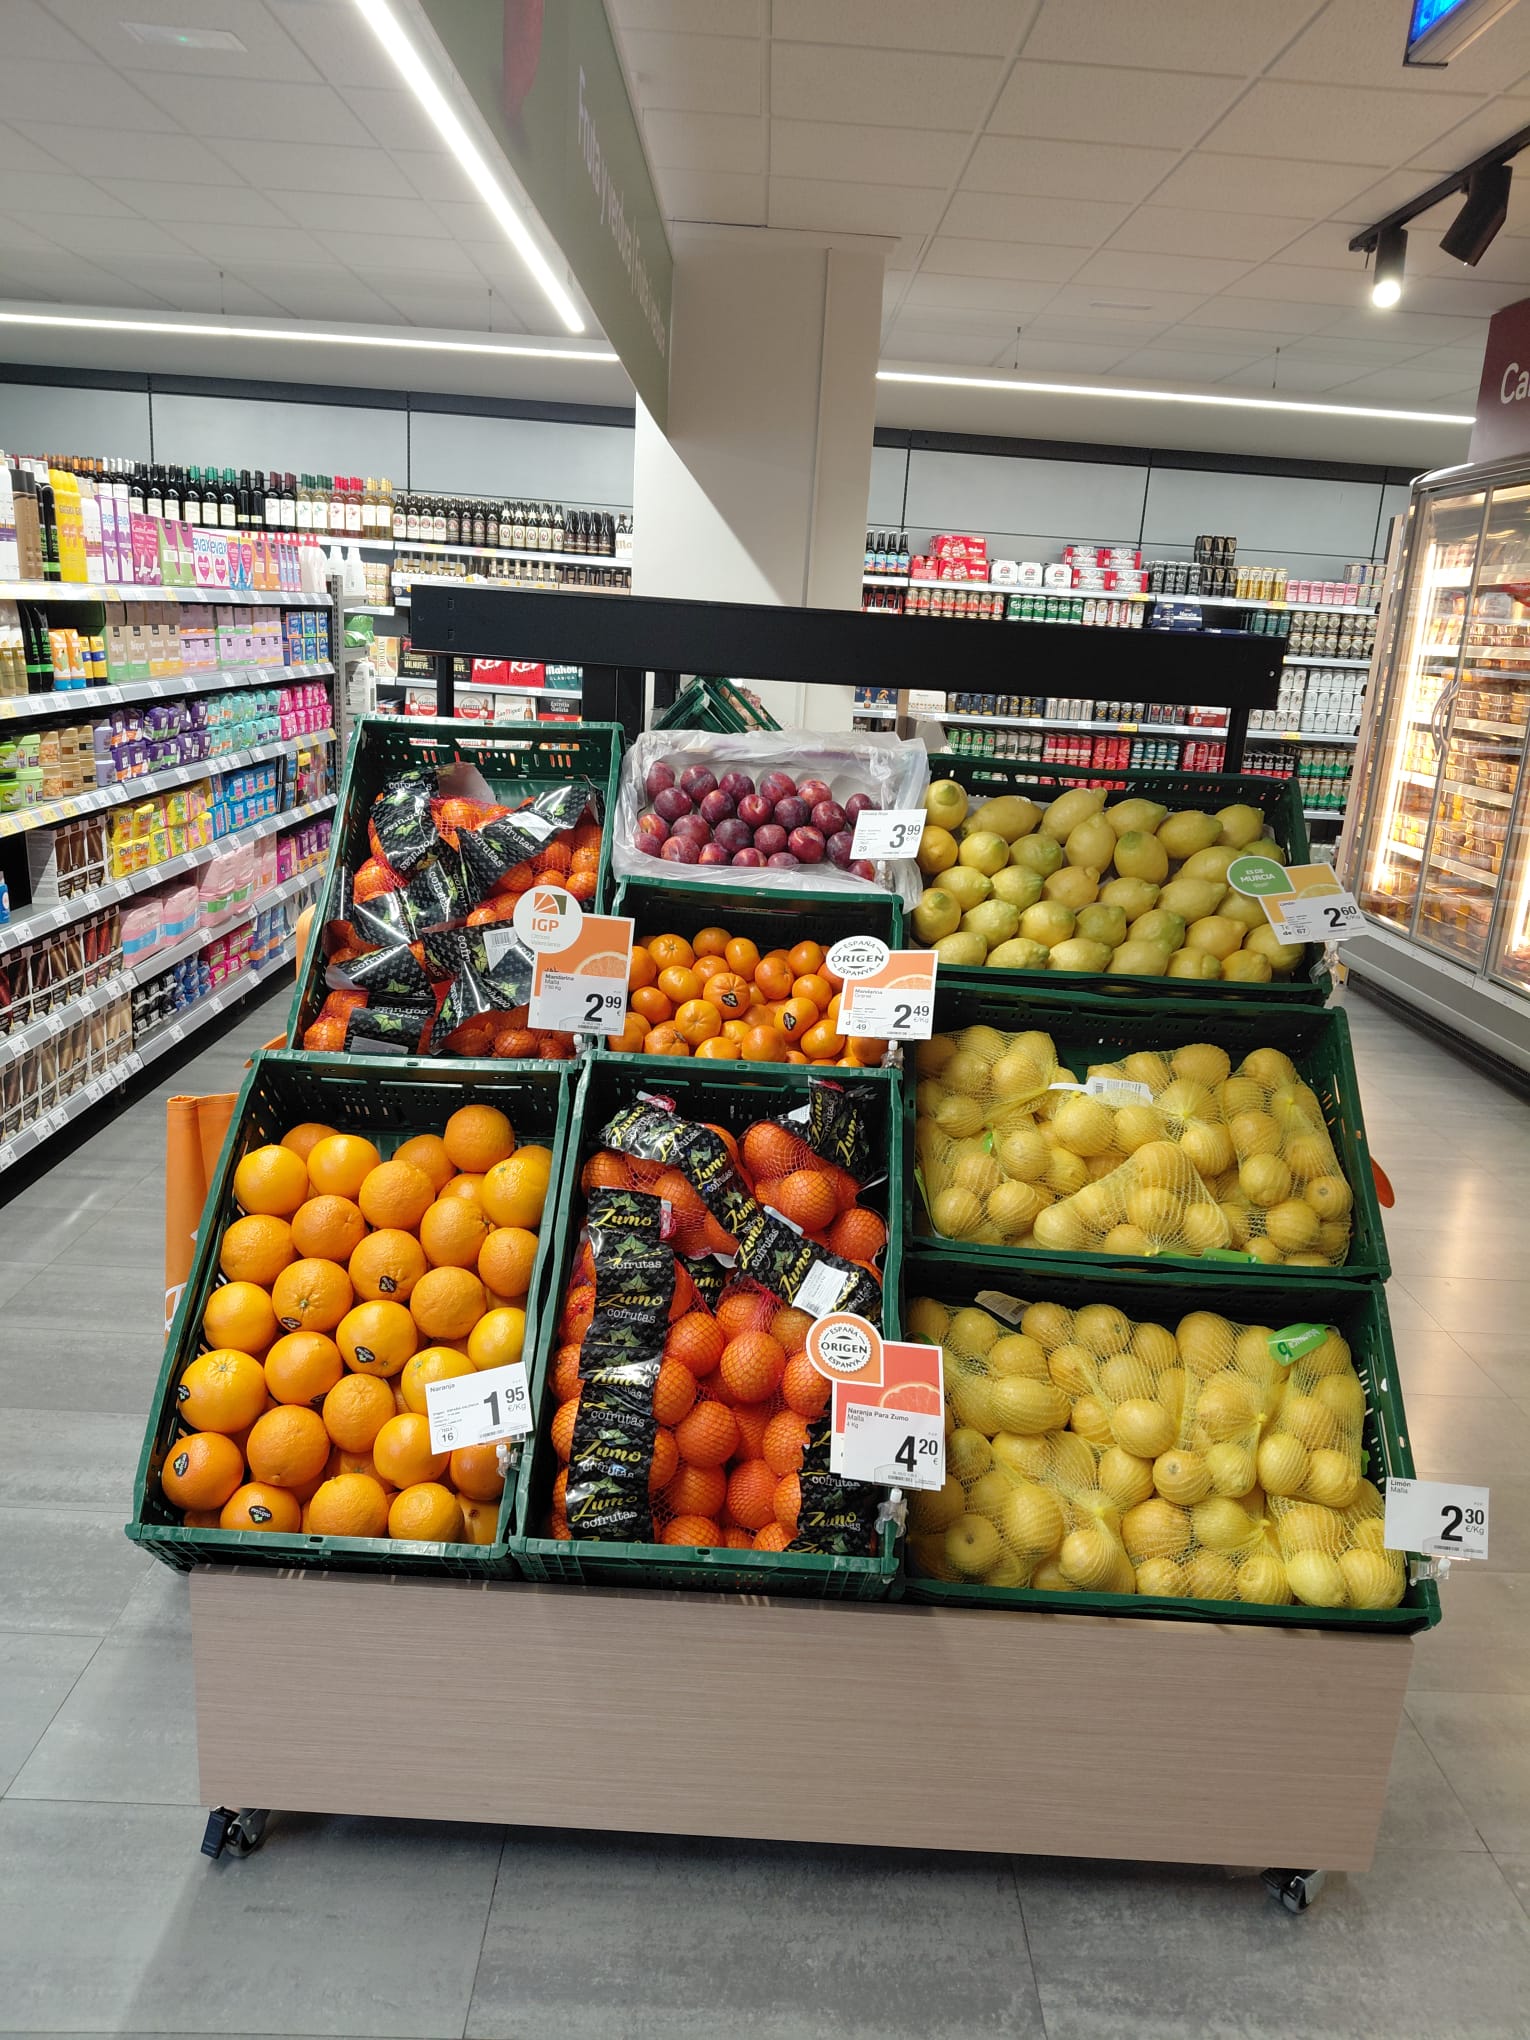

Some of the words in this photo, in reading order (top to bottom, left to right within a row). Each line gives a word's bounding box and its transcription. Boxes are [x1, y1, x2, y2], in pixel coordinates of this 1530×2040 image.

[578, 64, 600, 195] Fruta
[601, 158, 608, 225] y
[1500, 361, 1530, 405] Ca
[193, 537, 210, 551] evax
[210, 540, 227, 555] evax
[546, 665, 577, 675] Mahou
[889, 824, 906, 848] 3
[907, 824, 921, 835] 99
[1240, 873, 1276, 883] MURCIA
[1323, 907, 1346, 928] 2
[1341, 905, 1357, 916] 60
[531, 917, 560, 933] IGP
[831, 954, 885, 963] ORIGEN
[837, 966, 876, 977] ESPANYA
[583, 993, 604, 1023] 2
[605, 995, 622, 1009] 99
[892, 1004, 912, 1029] 2
[913, 1005, 930, 1017] 49
[856, 1023, 867, 1031] 49
[693, 1151, 727, 1190] Zumo
[591, 1207, 653, 1229] Zumo
[751, 1228, 779, 1268] cofrutas
[693, 1276, 723, 1289] umo
[779, 1247, 812, 1304] Zumo
[598, 1293, 664, 1309] Zumo
[606, 1308, 657, 1324] cofrutas
[829, 1326, 859, 1337] ESPAÑA
[820, 1341, 868, 1355] ORIGEN
[827, 1356, 862, 1369] ESPANYA
[430, 1383, 456, 1393] Naranja
[483, 1390, 501, 1426] 1
[505, 1386, 525, 1404] 95
[507, 1403, 526, 1412] €/Kg
[590, 1409, 646, 1428] cofrutas
[847, 1414, 865, 1422] Malla
[848, 1407, 873, 1417] Naranja
[874, 1411, 889, 1419] Para
[890, 1413, 910, 1422] Zumo
[441, 1432, 454, 1443] 16
[573, 1439, 642, 1462] Zumo
[895, 1435, 918, 1473] 4
[918, 1438, 938, 1456] 20
[933, 1458, 938, 1466] €
[1390, 1479, 1411, 1487] Limón
[571, 1494, 638, 1523] Zumo
[582, 1510, 638, 1529] cofrutas
[1441, 1504, 1463, 1542] 2
[1464, 1508, 1484, 1525] 30
[1465, 1525, 1485, 1536] €/Kg
